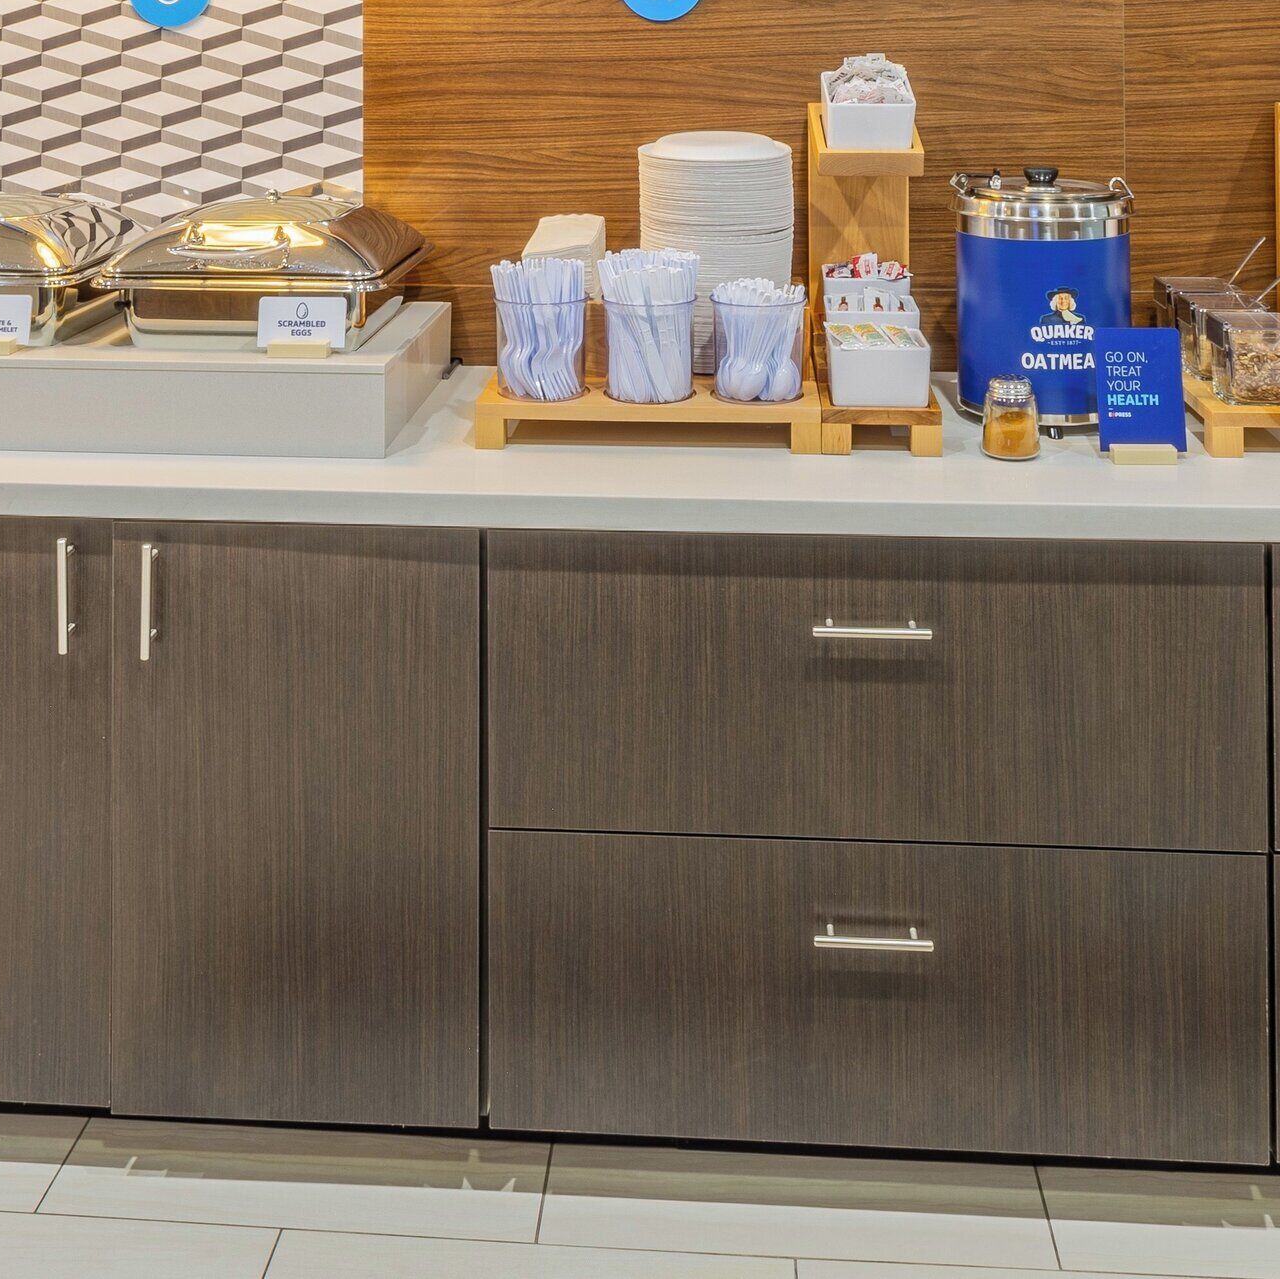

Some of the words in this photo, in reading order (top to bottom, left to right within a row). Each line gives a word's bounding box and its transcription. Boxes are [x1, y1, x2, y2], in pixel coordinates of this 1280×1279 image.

[278, 320, 326, 328] SCRAMBLED
[291, 329, 312, 337] EGGS
[1030, 324, 1094, 342] QUAKER
[1021, 353, 1095, 370] OATMEA
[1105, 351, 1123, 363] GO
[1127, 351, 1148, 363] ON,
[1106, 365, 1142, 377] TREAT
[1107, 380, 1141, 392] YOUR
[1107, 394, 1159, 406] HEALTH
